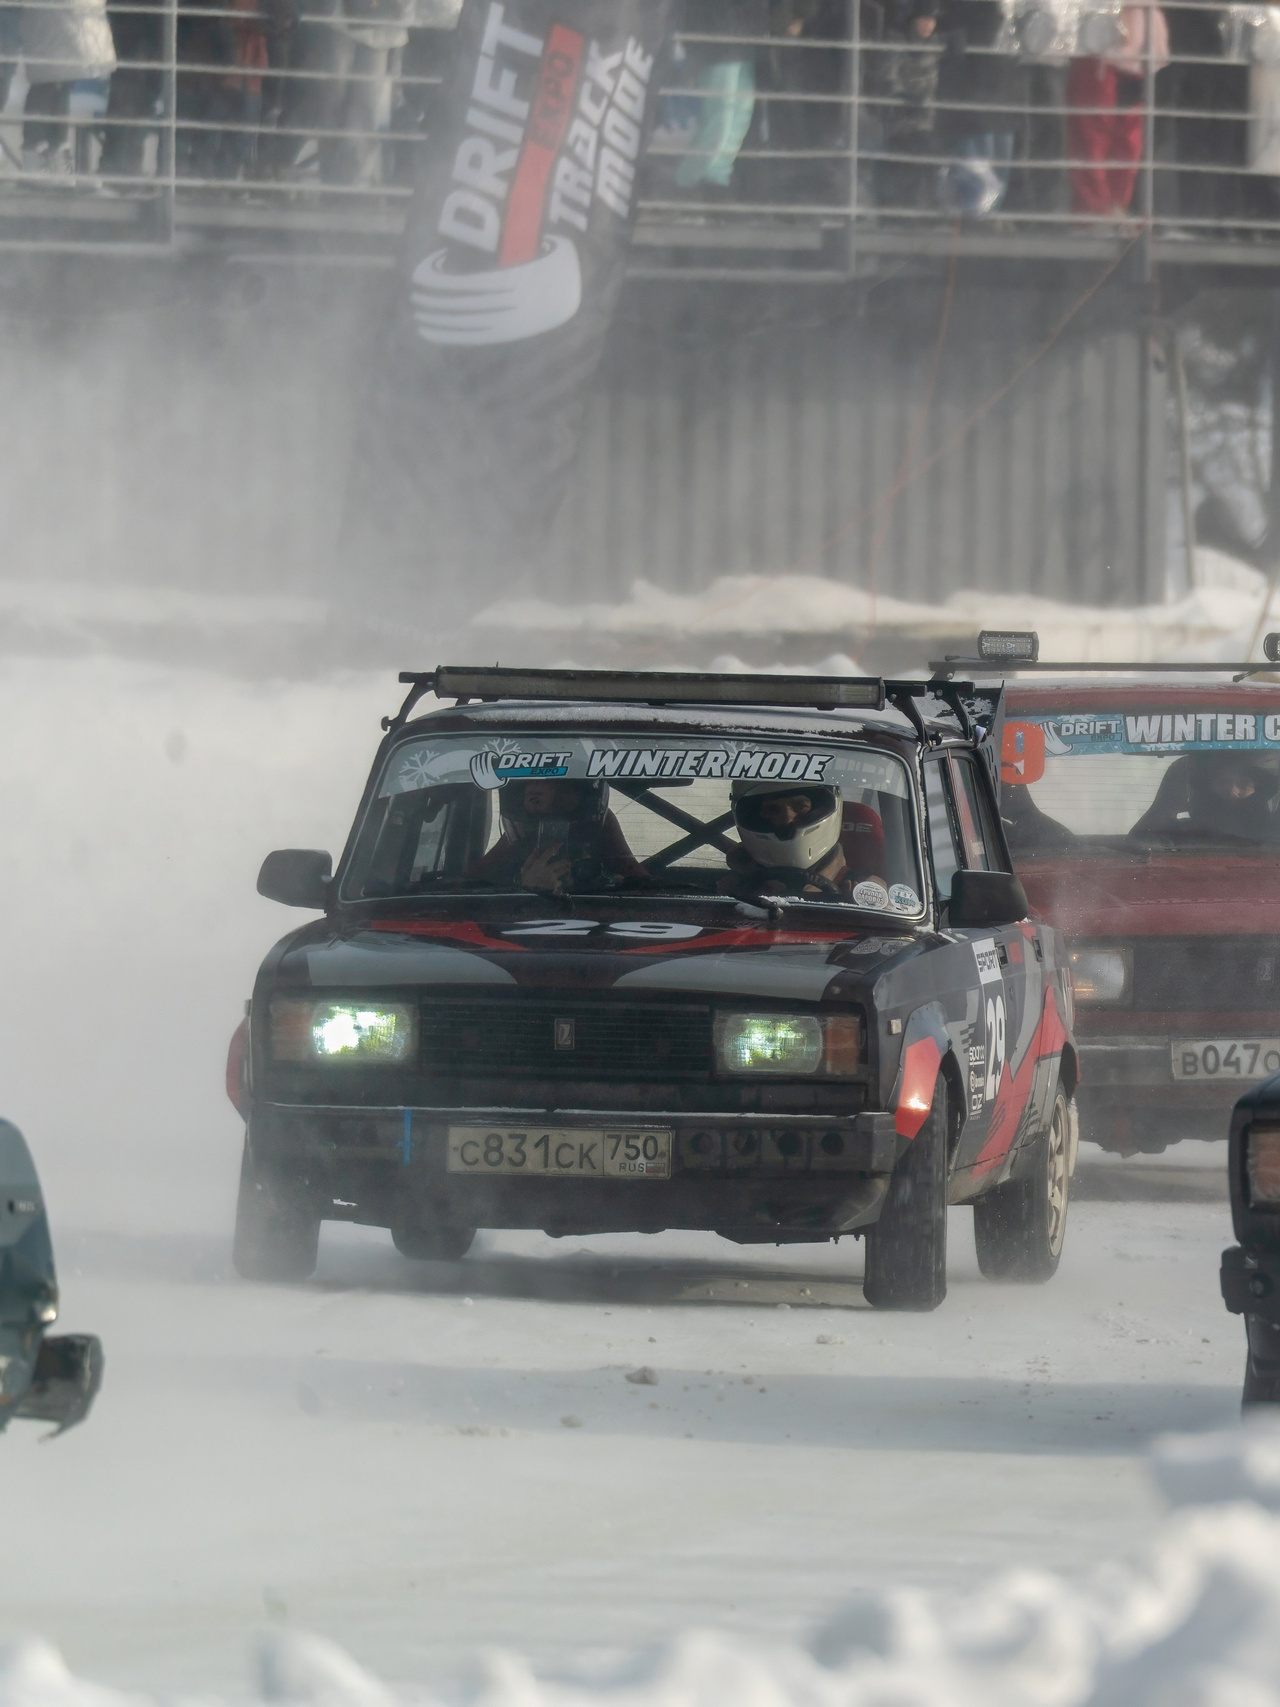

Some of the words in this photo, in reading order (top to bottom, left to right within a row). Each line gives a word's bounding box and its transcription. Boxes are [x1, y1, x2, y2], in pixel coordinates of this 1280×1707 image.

[438, 1, 544, 252] DRIFT
[1060, 719, 1121, 735] DRIFT
[1126, 713, 1257, 743] WINTER
[499, 751, 573, 768] DRIFT
[587, 750, 728, 778] WINTER
[731, 751, 834, 782] MODE
[501, 919, 703, 939] 29
[986, 995, 1006, 1101] 29
[606, 1133, 659, 1161] 750
[619, 1162, 645, 1173] RUS
